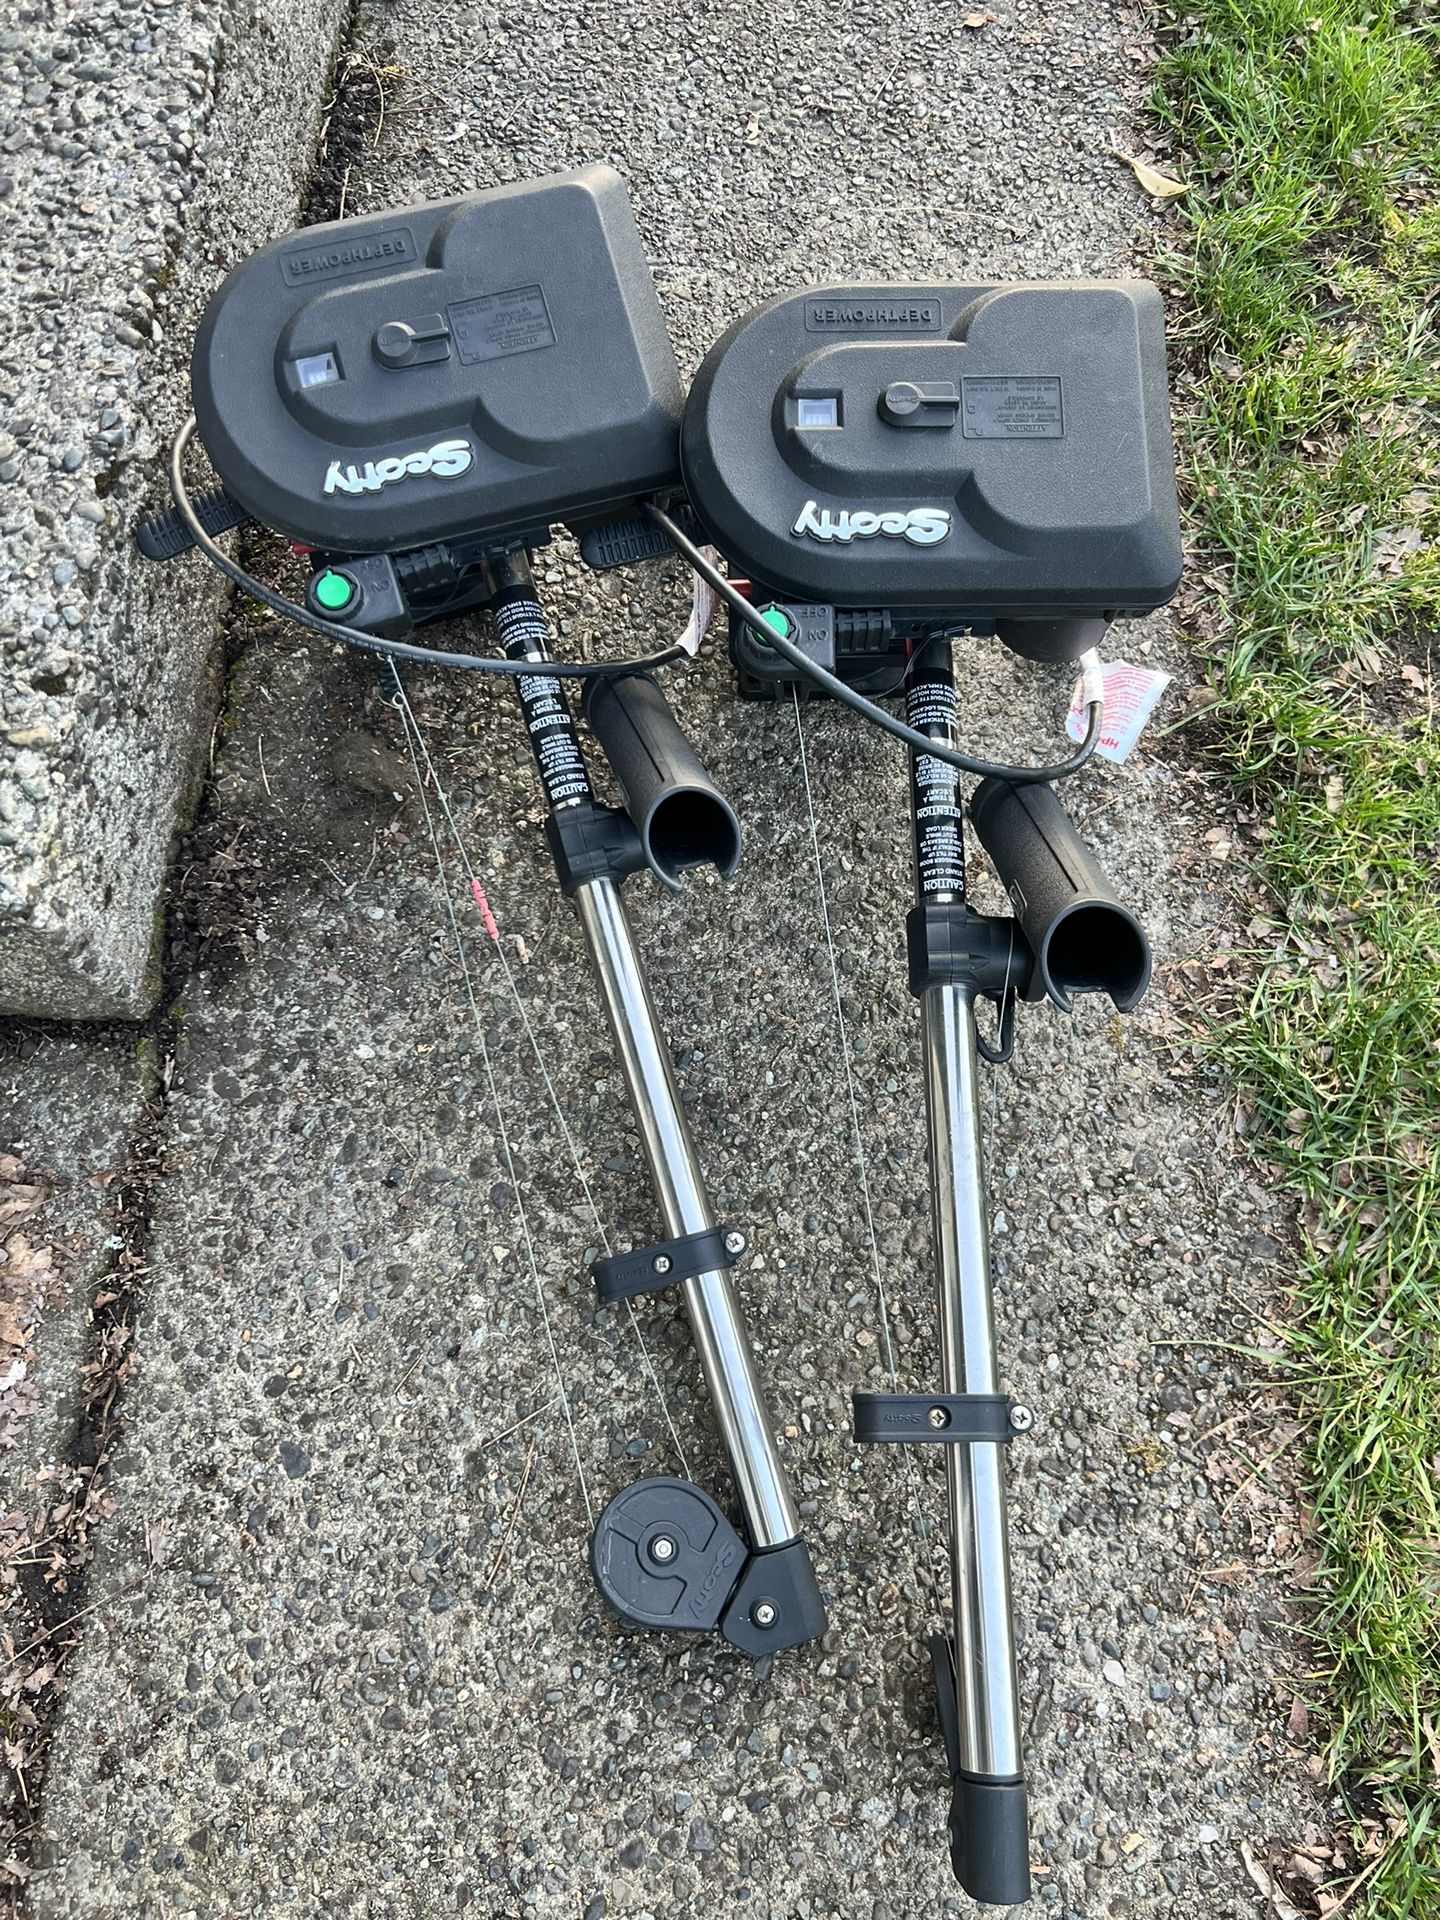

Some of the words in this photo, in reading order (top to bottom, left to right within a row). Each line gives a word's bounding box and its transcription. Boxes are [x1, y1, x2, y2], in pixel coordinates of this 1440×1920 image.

[288, 239, 405, 275] DEPTHPOWER
[814, 308, 931, 322] DEPTHPOWER
[321, 439, 473, 497] Scotty
[792, 499, 949, 546] Scotty
[801, 607, 827, 617] OFF
[807, 630, 827, 640] ON
[529, 714, 570, 732] ATTENTION
[550, 783, 587, 799] CAUTION
[916, 805, 960, 818] ATTENTION
[923, 868, 943, 876] CLEAR
[923, 878, 963, 890] CAUTION
[686, 1541, 739, 1619] Scotty
